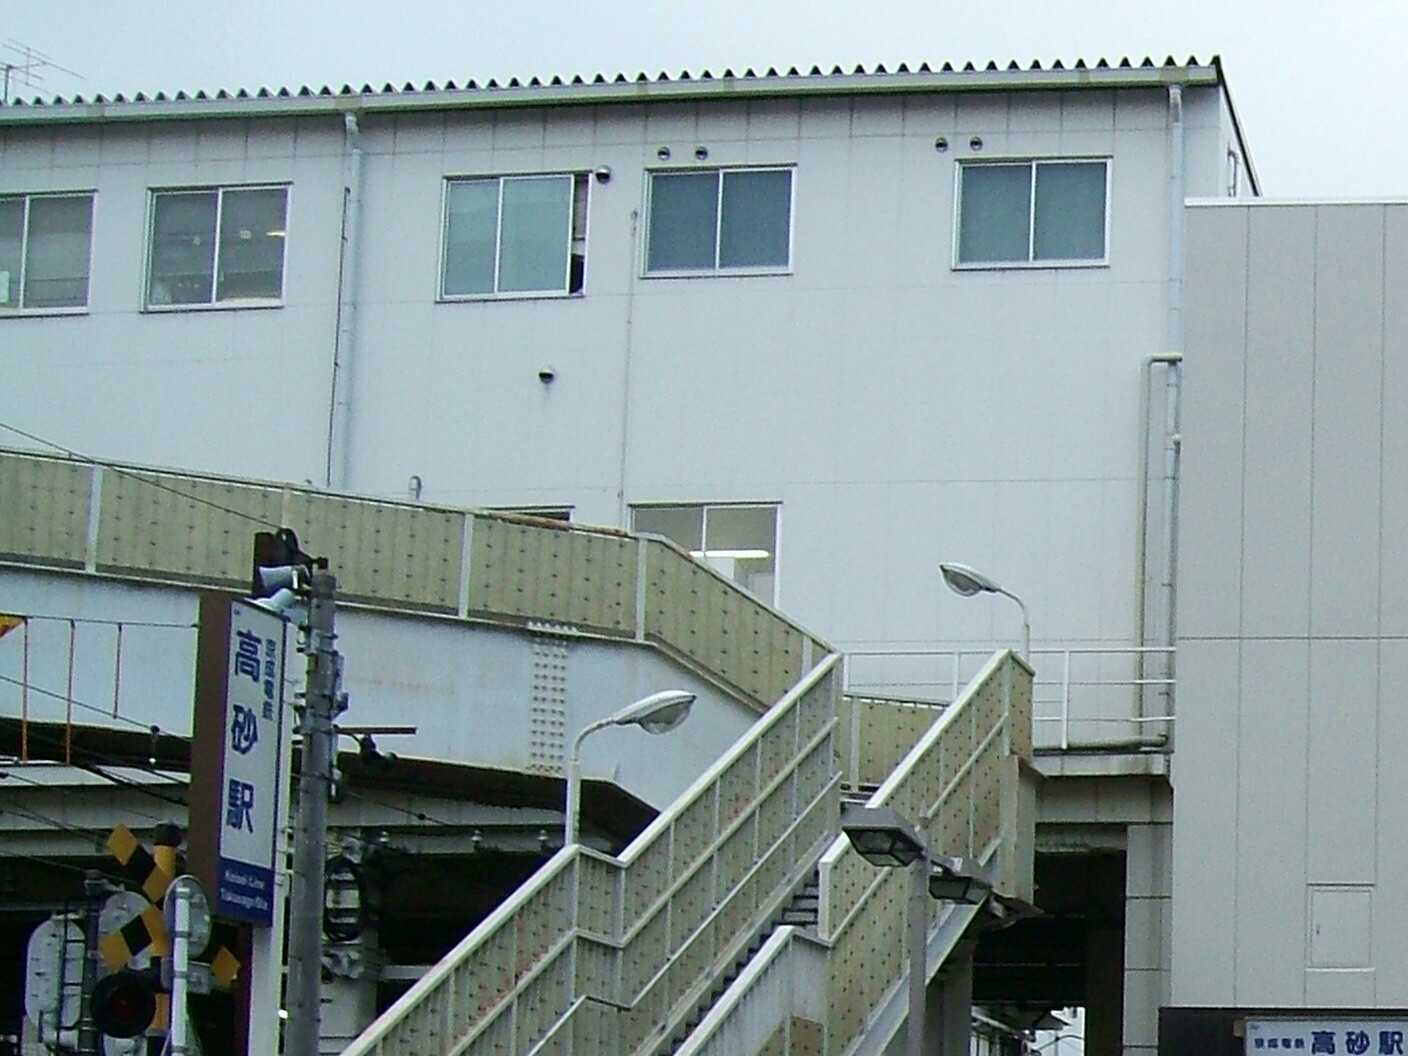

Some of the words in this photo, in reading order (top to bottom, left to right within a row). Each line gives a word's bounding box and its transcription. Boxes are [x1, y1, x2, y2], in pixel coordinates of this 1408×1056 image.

[227, 629, 262, 833] 高砂駅
[1311, 1030, 1404, 1055] 高砂駅
